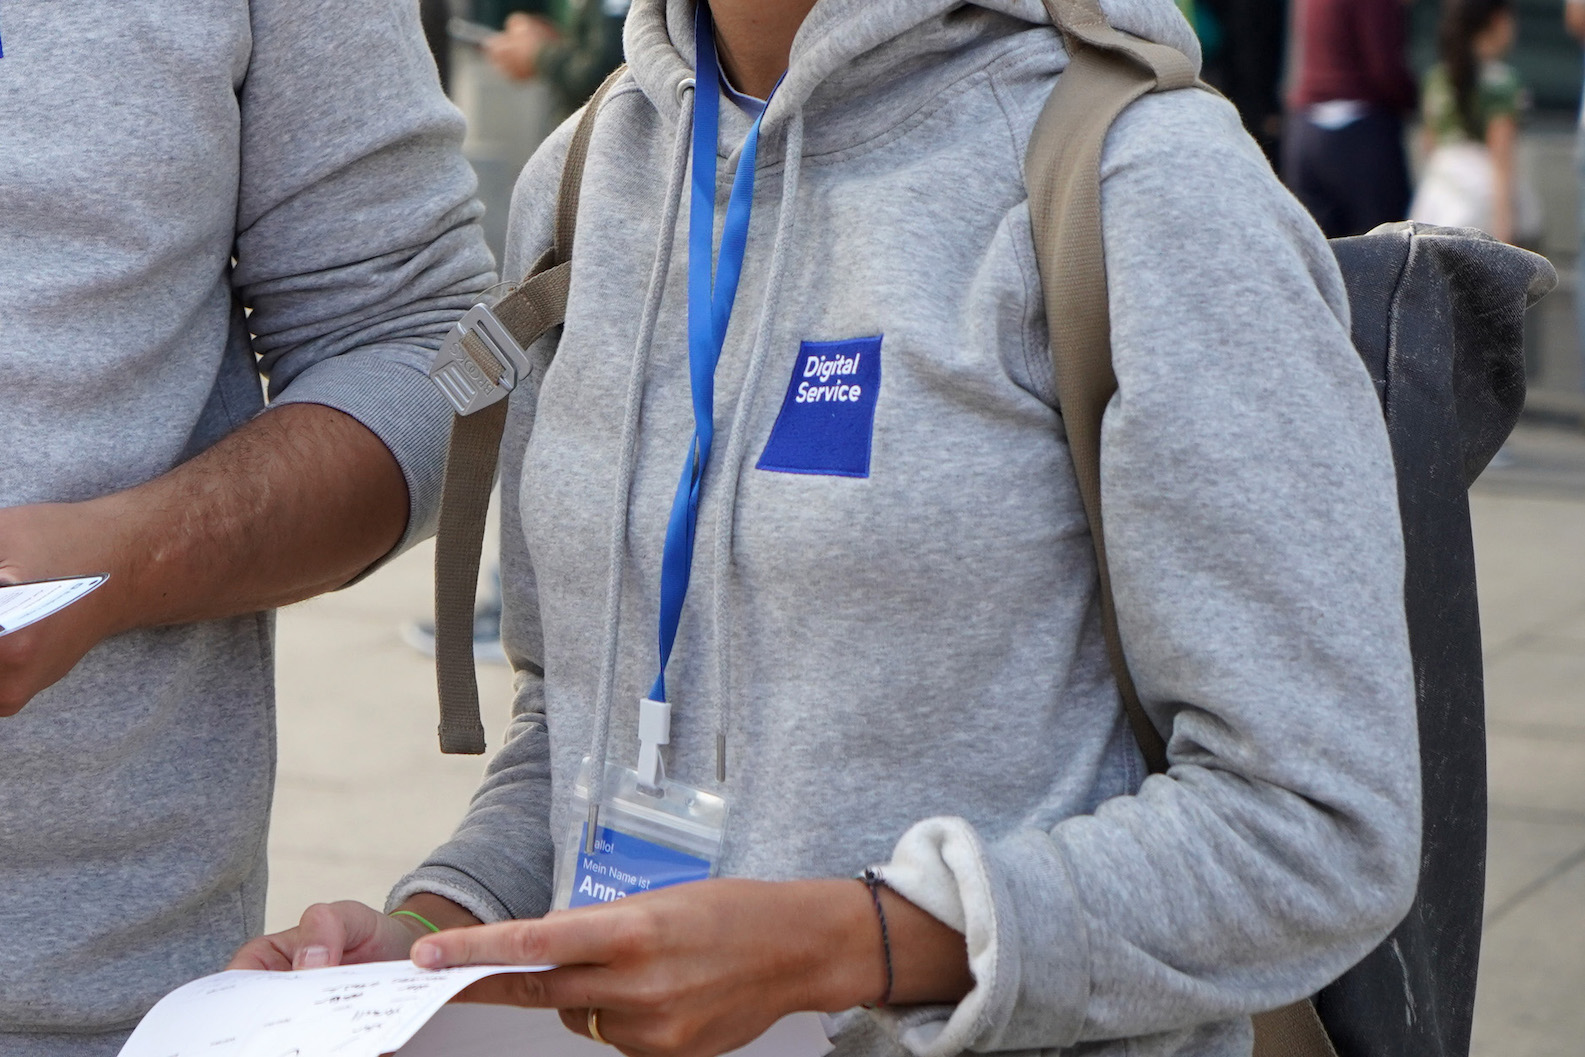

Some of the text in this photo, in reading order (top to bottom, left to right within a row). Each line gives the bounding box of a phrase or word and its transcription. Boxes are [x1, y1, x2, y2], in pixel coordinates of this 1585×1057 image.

[803, 352, 861, 383] Digital
[795, 379, 862, 404] Service
[594, 839, 614, 854] allo!
[583, 857, 651, 890] Mein Name ist
